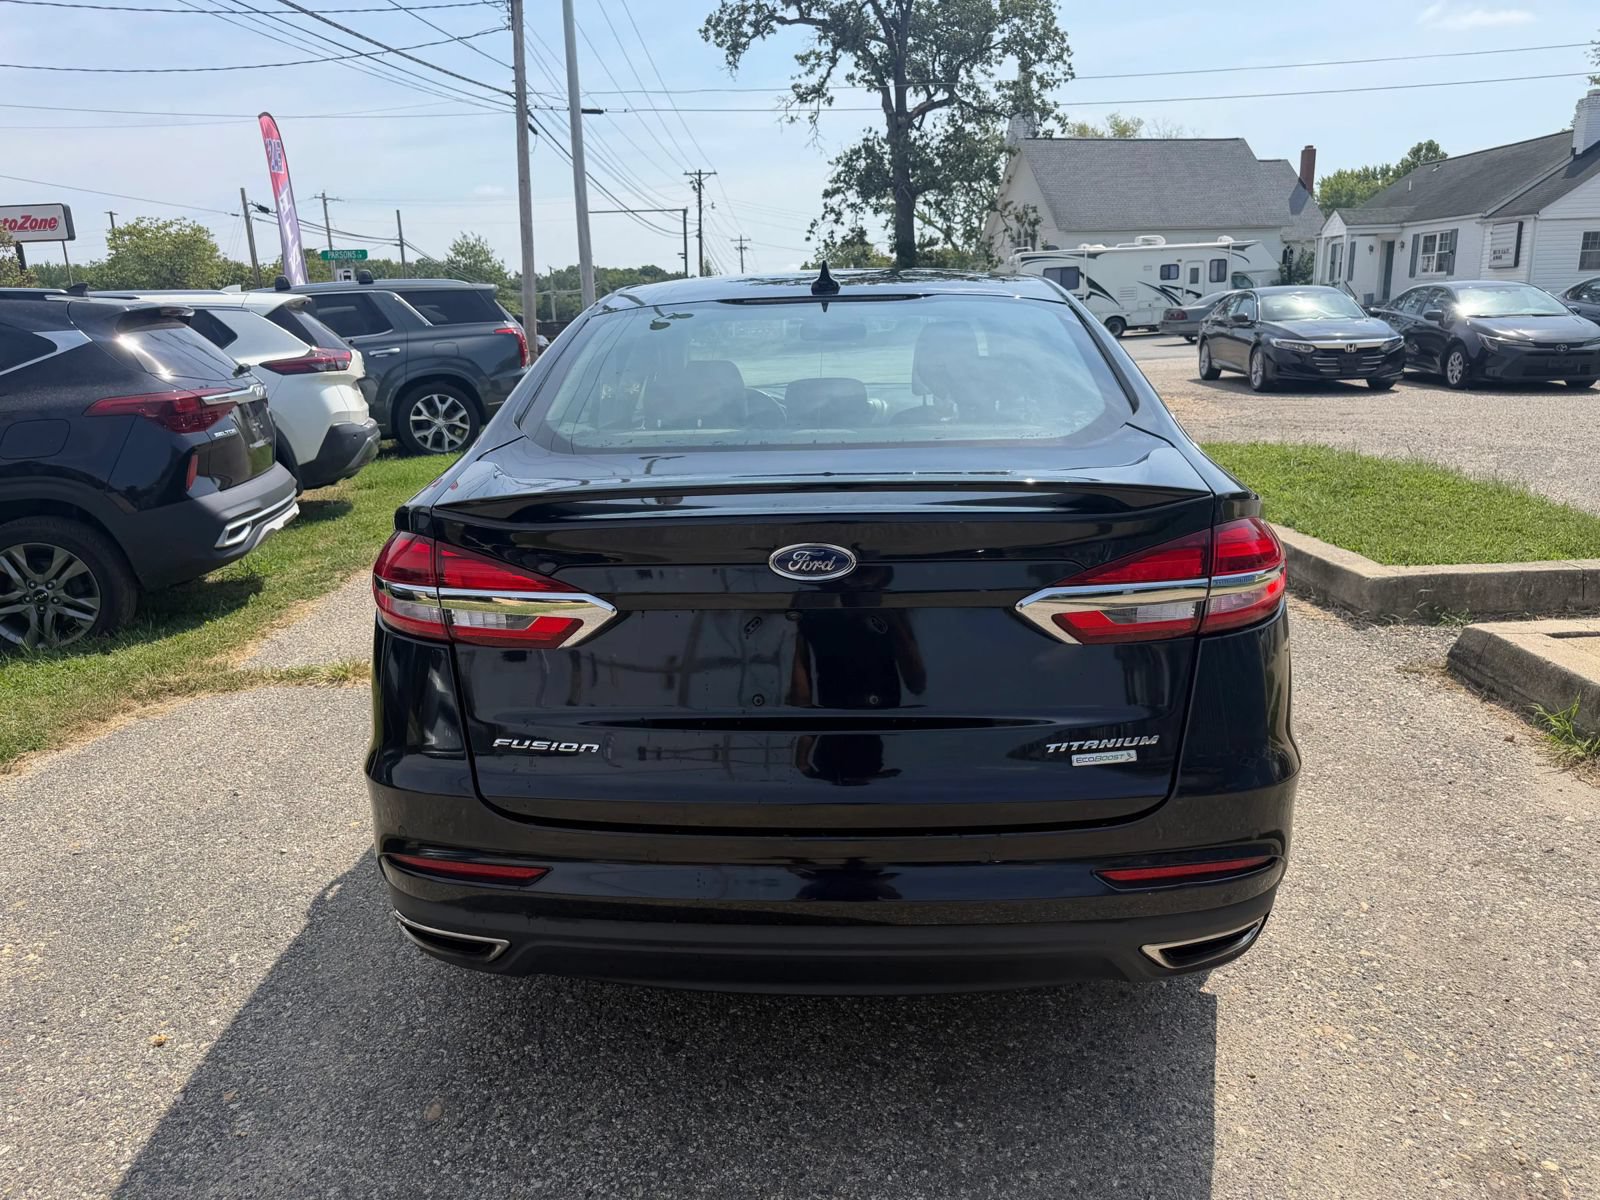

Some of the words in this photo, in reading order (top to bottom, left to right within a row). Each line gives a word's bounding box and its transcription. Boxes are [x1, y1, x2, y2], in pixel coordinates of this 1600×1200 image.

[0, 215, 58, 231] toZone
[328, 250, 356, 259] PARSONS
[788, 551, 836, 571] Ford
[493, 738, 600, 753] FUSION
[1046, 735, 1159, 753] TITANIUM
